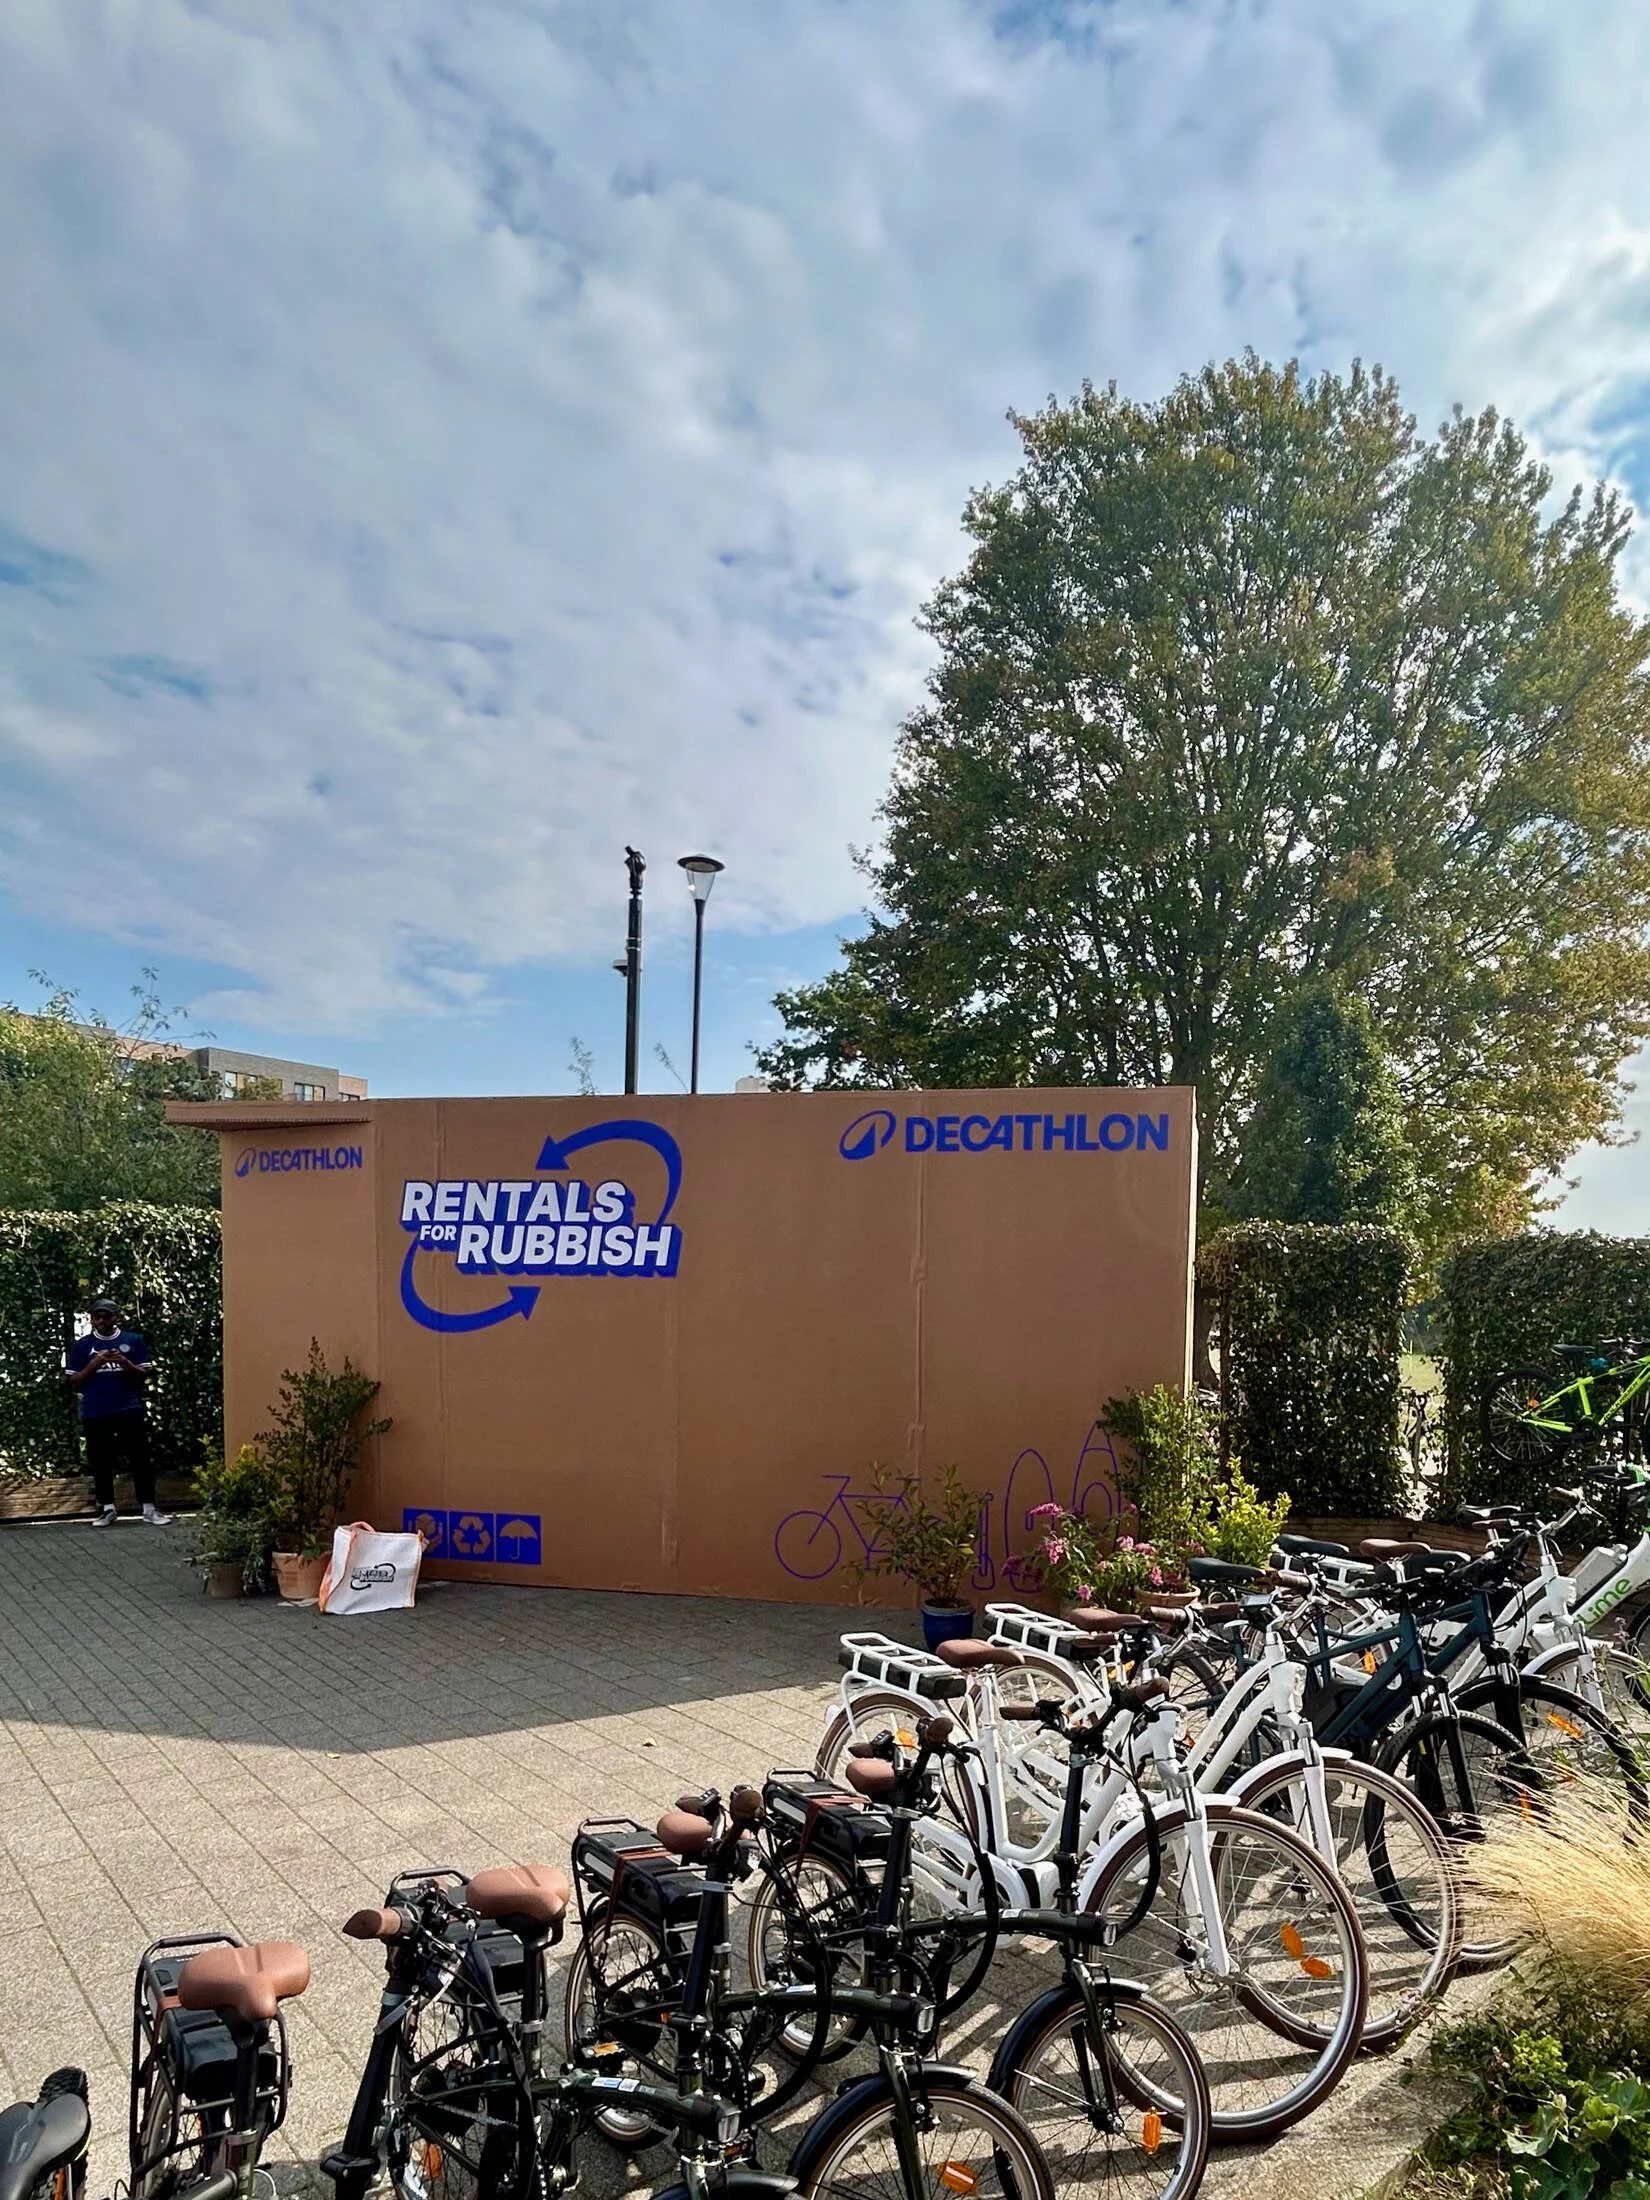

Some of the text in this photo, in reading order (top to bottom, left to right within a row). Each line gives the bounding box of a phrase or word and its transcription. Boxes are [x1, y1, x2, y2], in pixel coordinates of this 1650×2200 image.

[905, 1113, 1169, 1152] DECATHLON
[258, 1145, 363, 1173] DECATHLON
[401, 1181, 627, 1223] RENTALS
[419, 1224, 673, 1267] FOR RUBBISH
[1576, 1579, 1632, 1625] Lime
